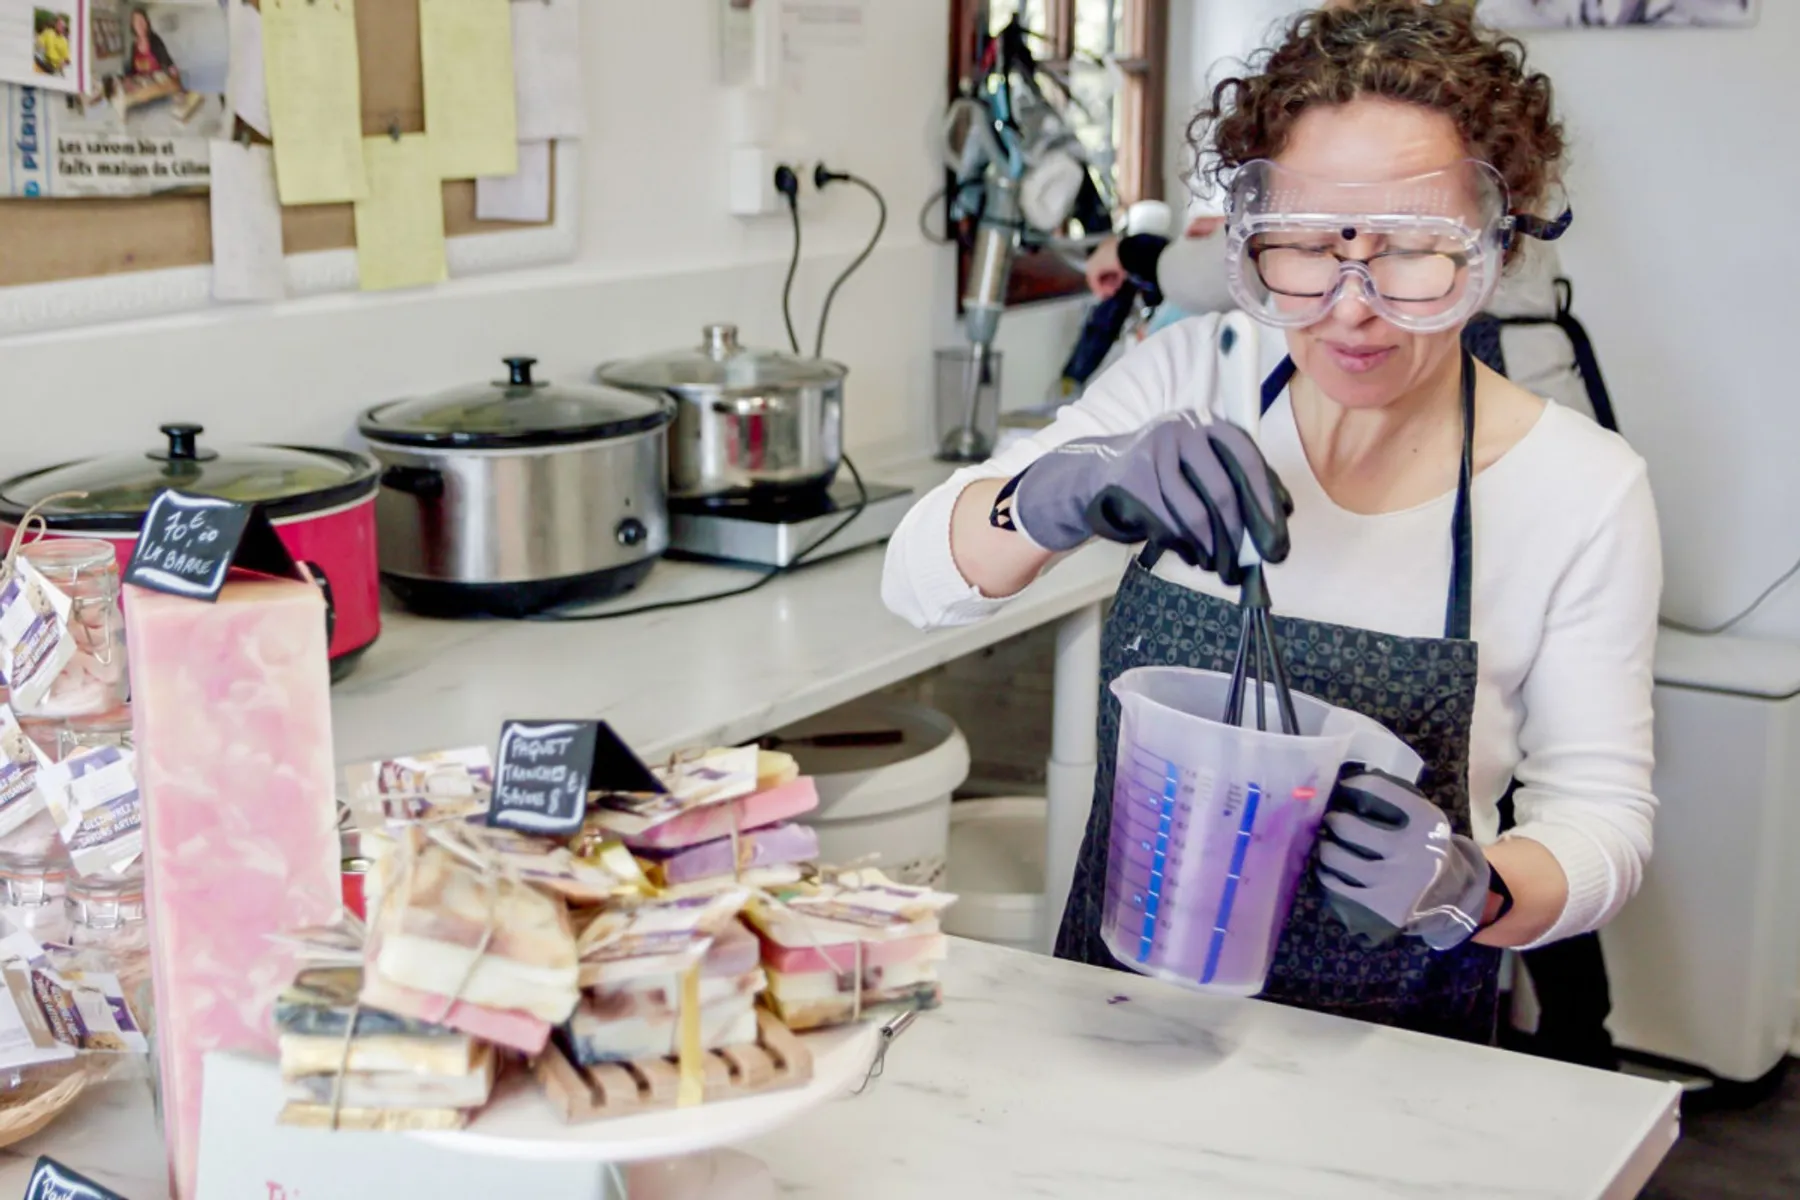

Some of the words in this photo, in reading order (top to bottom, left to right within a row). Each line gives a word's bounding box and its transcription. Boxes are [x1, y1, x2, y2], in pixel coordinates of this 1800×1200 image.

[58, 138, 82, 155] Les
[87, 139, 135, 155] savons
[138, 138, 157, 155] bio
[161, 141, 174, 155] et
[58, 158, 92, 175] faits
[97, 161, 149, 176] maison
[154, 160, 168, 176] de
[161, 550, 214, 575] BARRE
[511, 736, 574, 762] PAQUET
